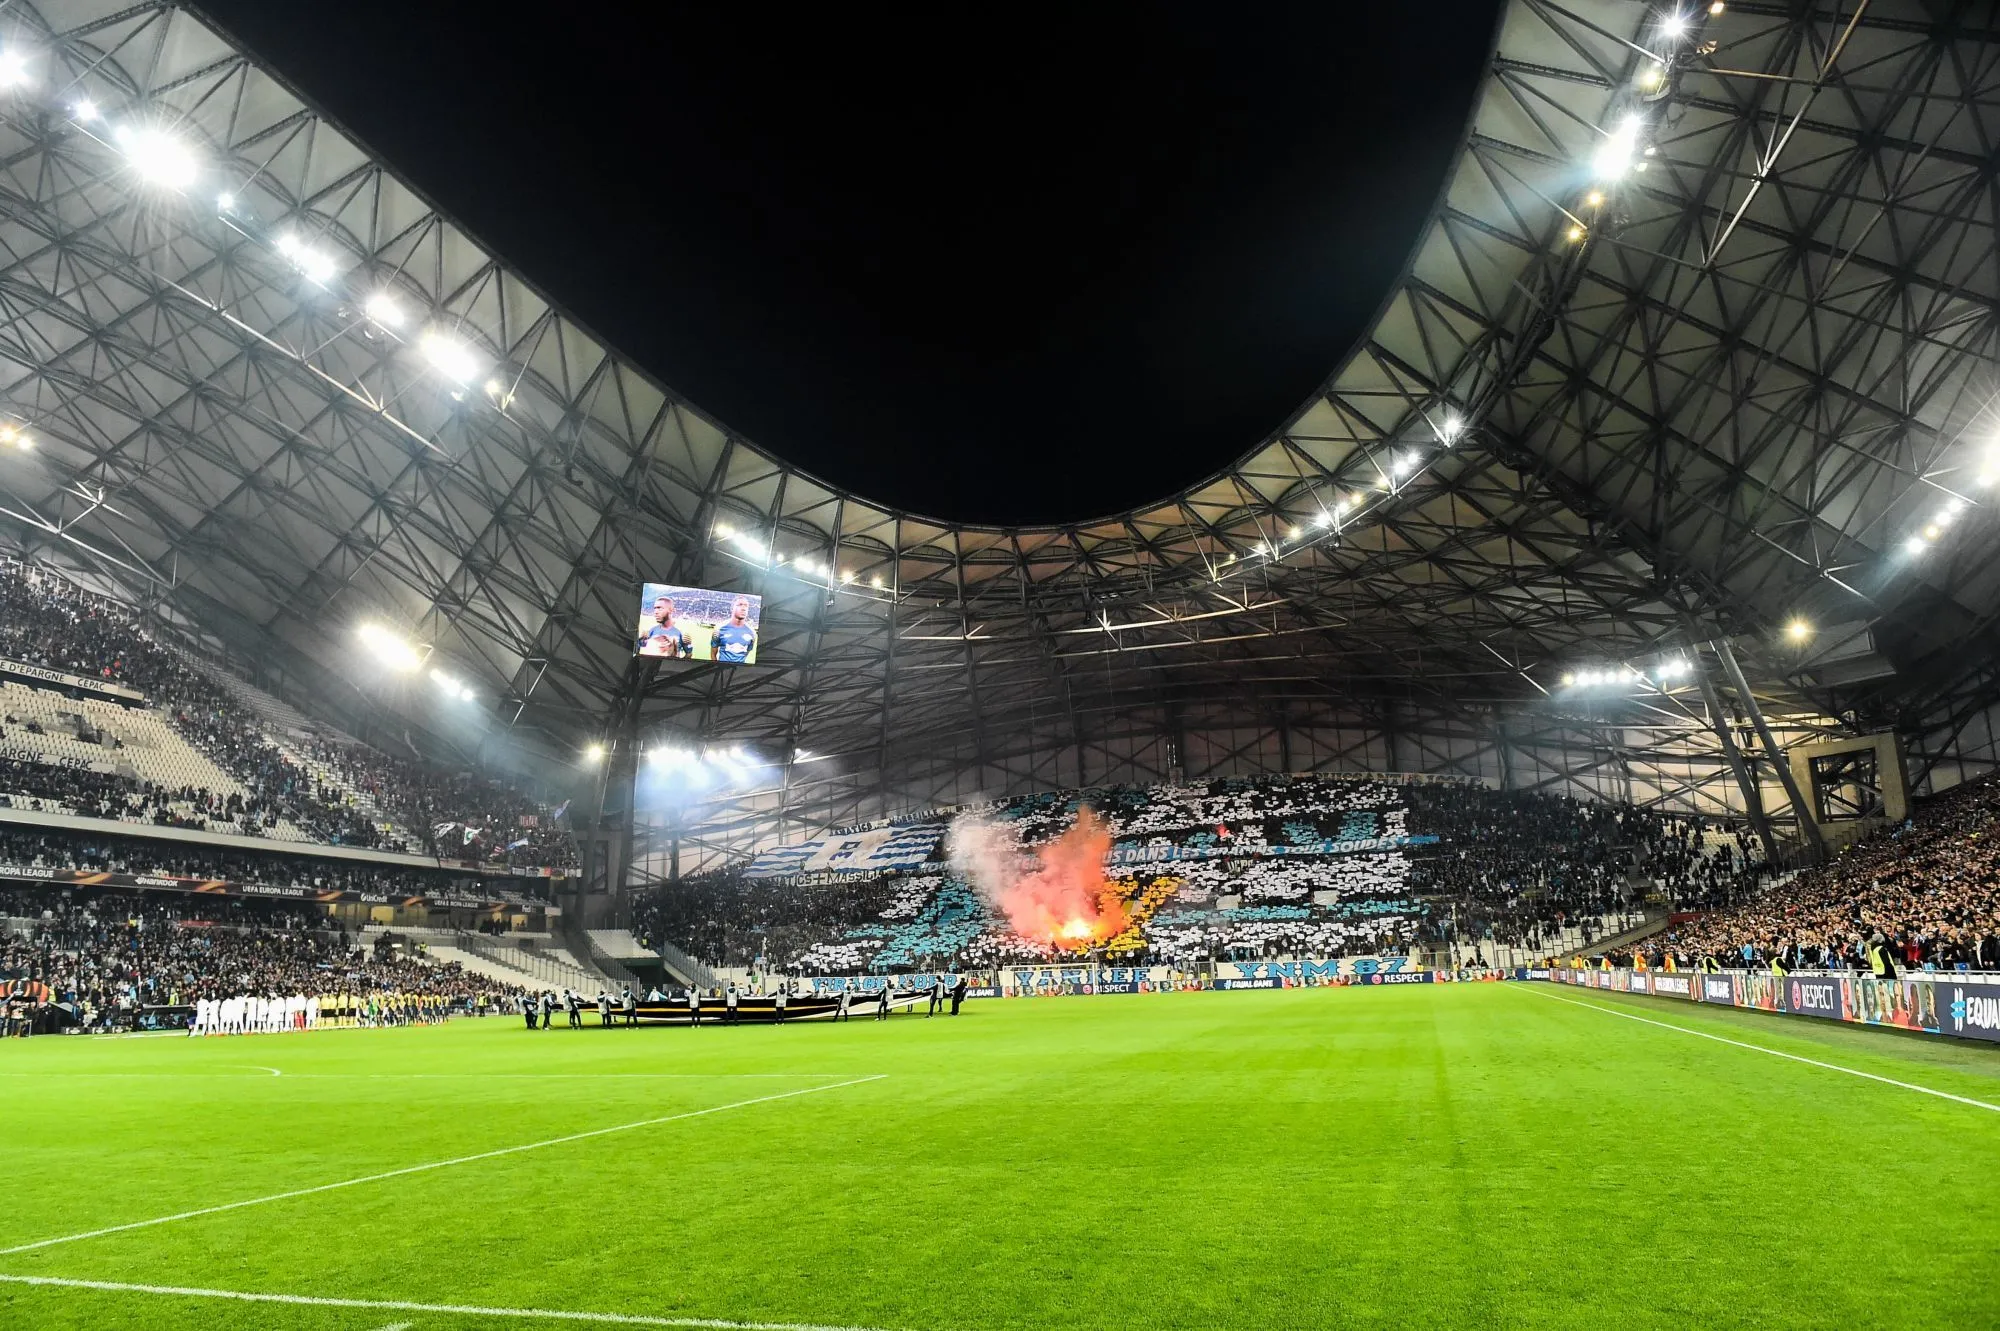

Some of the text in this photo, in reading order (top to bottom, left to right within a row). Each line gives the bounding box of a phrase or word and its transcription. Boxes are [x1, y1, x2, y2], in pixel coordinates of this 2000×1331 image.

[77, 678, 105, 691] CEPAC
[60, 757, 93, 771] CEPAC
[1125, 847, 1169, 863] DANS
[1173, 847, 1200, 860] LES
[22, 868, 54, 878] LEAGUE
[242, 885, 304, 896] UEFA EUROPA LEAGUE
[1234, 957, 1408, 979] YNM 87
[1015, 968, 1151, 986] YANKEE
[1384, 972, 1424, 984] RESPECT
[1095, 983, 1131, 993] RESPECT
[1801, 984, 1834, 1010] RESPECT
